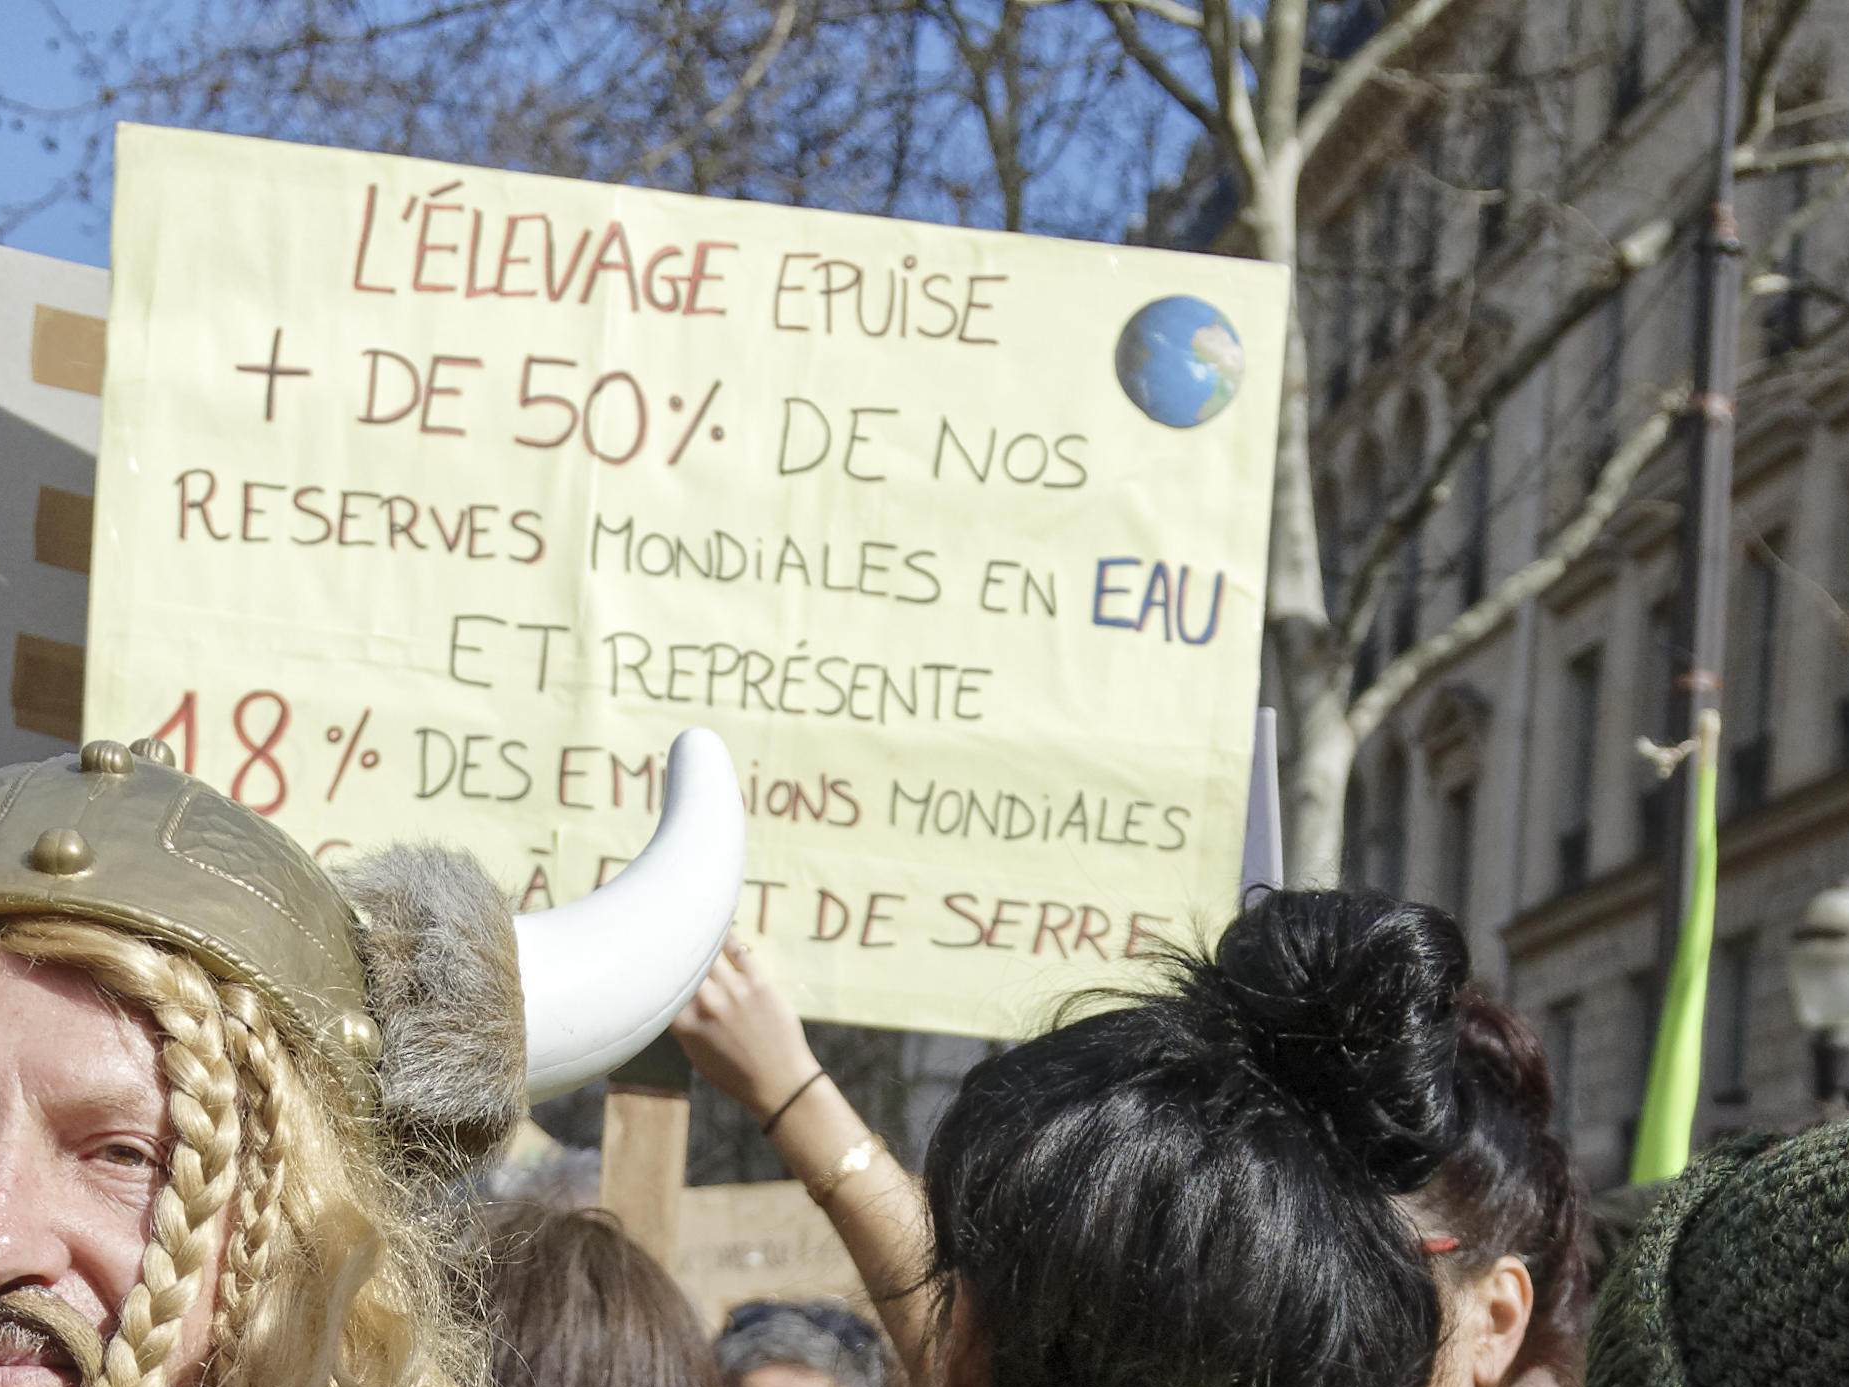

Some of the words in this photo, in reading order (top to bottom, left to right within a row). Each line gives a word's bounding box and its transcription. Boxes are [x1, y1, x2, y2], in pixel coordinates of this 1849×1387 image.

[353, 181, 738, 316] L'ÉLEVAGE
[356, 348, 483, 436] DE
[514, 354, 725, 466] 50%
[778, 397, 899, 482] DE
[934, 416, 1088, 488] NOS
[174, 468, 547, 564] RESERVES
[980, 561, 1056, 618] EN
[1092, 557, 1225, 646] EAU
[447, 612, 569, 694] ET
[602, 640, 992, 725] REPRÉSENTE
[414, 727, 533, 802] DES
[808, 889, 907, 948] DE
[931, 892, 1173, 961] SERRE
